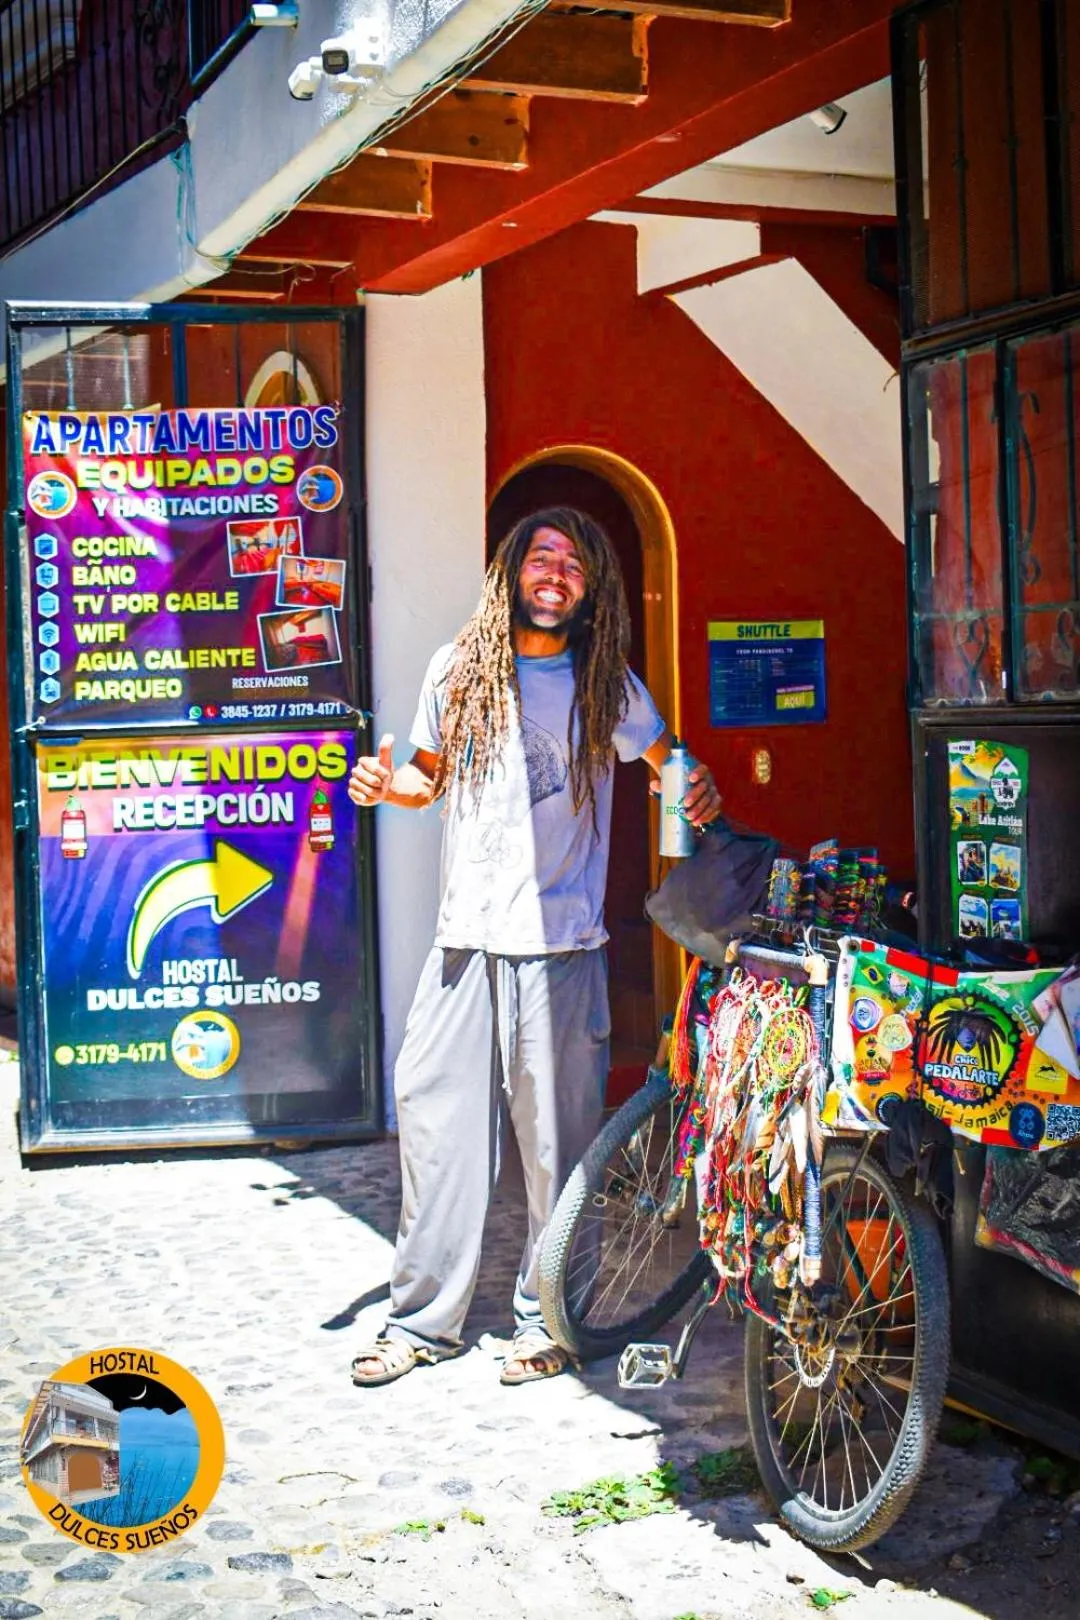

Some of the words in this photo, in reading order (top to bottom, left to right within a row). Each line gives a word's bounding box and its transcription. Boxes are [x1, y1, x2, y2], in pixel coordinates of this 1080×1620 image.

[30, 406, 338, 455] APARTAMENTOS
[76, 455, 296, 492] EQUIPADOS
[93, 498, 109, 517] Y
[113, 493, 279, 518] HABITACIONES
[72, 536, 158, 557] COCINA
[72, 594, 106, 615] TV
[111, 592, 160, 614] POR
[165, 591, 240, 612] CABLE
[73, 622, 127, 644] WIFI
[737, 623, 792, 638] SHUTTLE
[75, 651, 138, 672] AGUA
[144, 647, 256, 670] CALIENTE
[74, 677, 183, 702] PARQUEO
[232, 675, 309, 689] RESERVACIONES
[221, 703, 277, 718] 3845-1237
[288, 702, 341, 717] 3179-4171
[47, 744, 348, 790] BIENVENIDOS
[113, 784, 294, 832] RECEPCIÓN
[162, 958, 243, 985] HOSTAL
[87, 985, 200, 1011] DULCES
[205, 976, 321, 1007] SUEÑOS
[1012, 1000, 1040, 1037] 2015
[76, 1042, 167, 1064] 3179-4171
[924, 1063, 999, 1086] PEDALARTE
